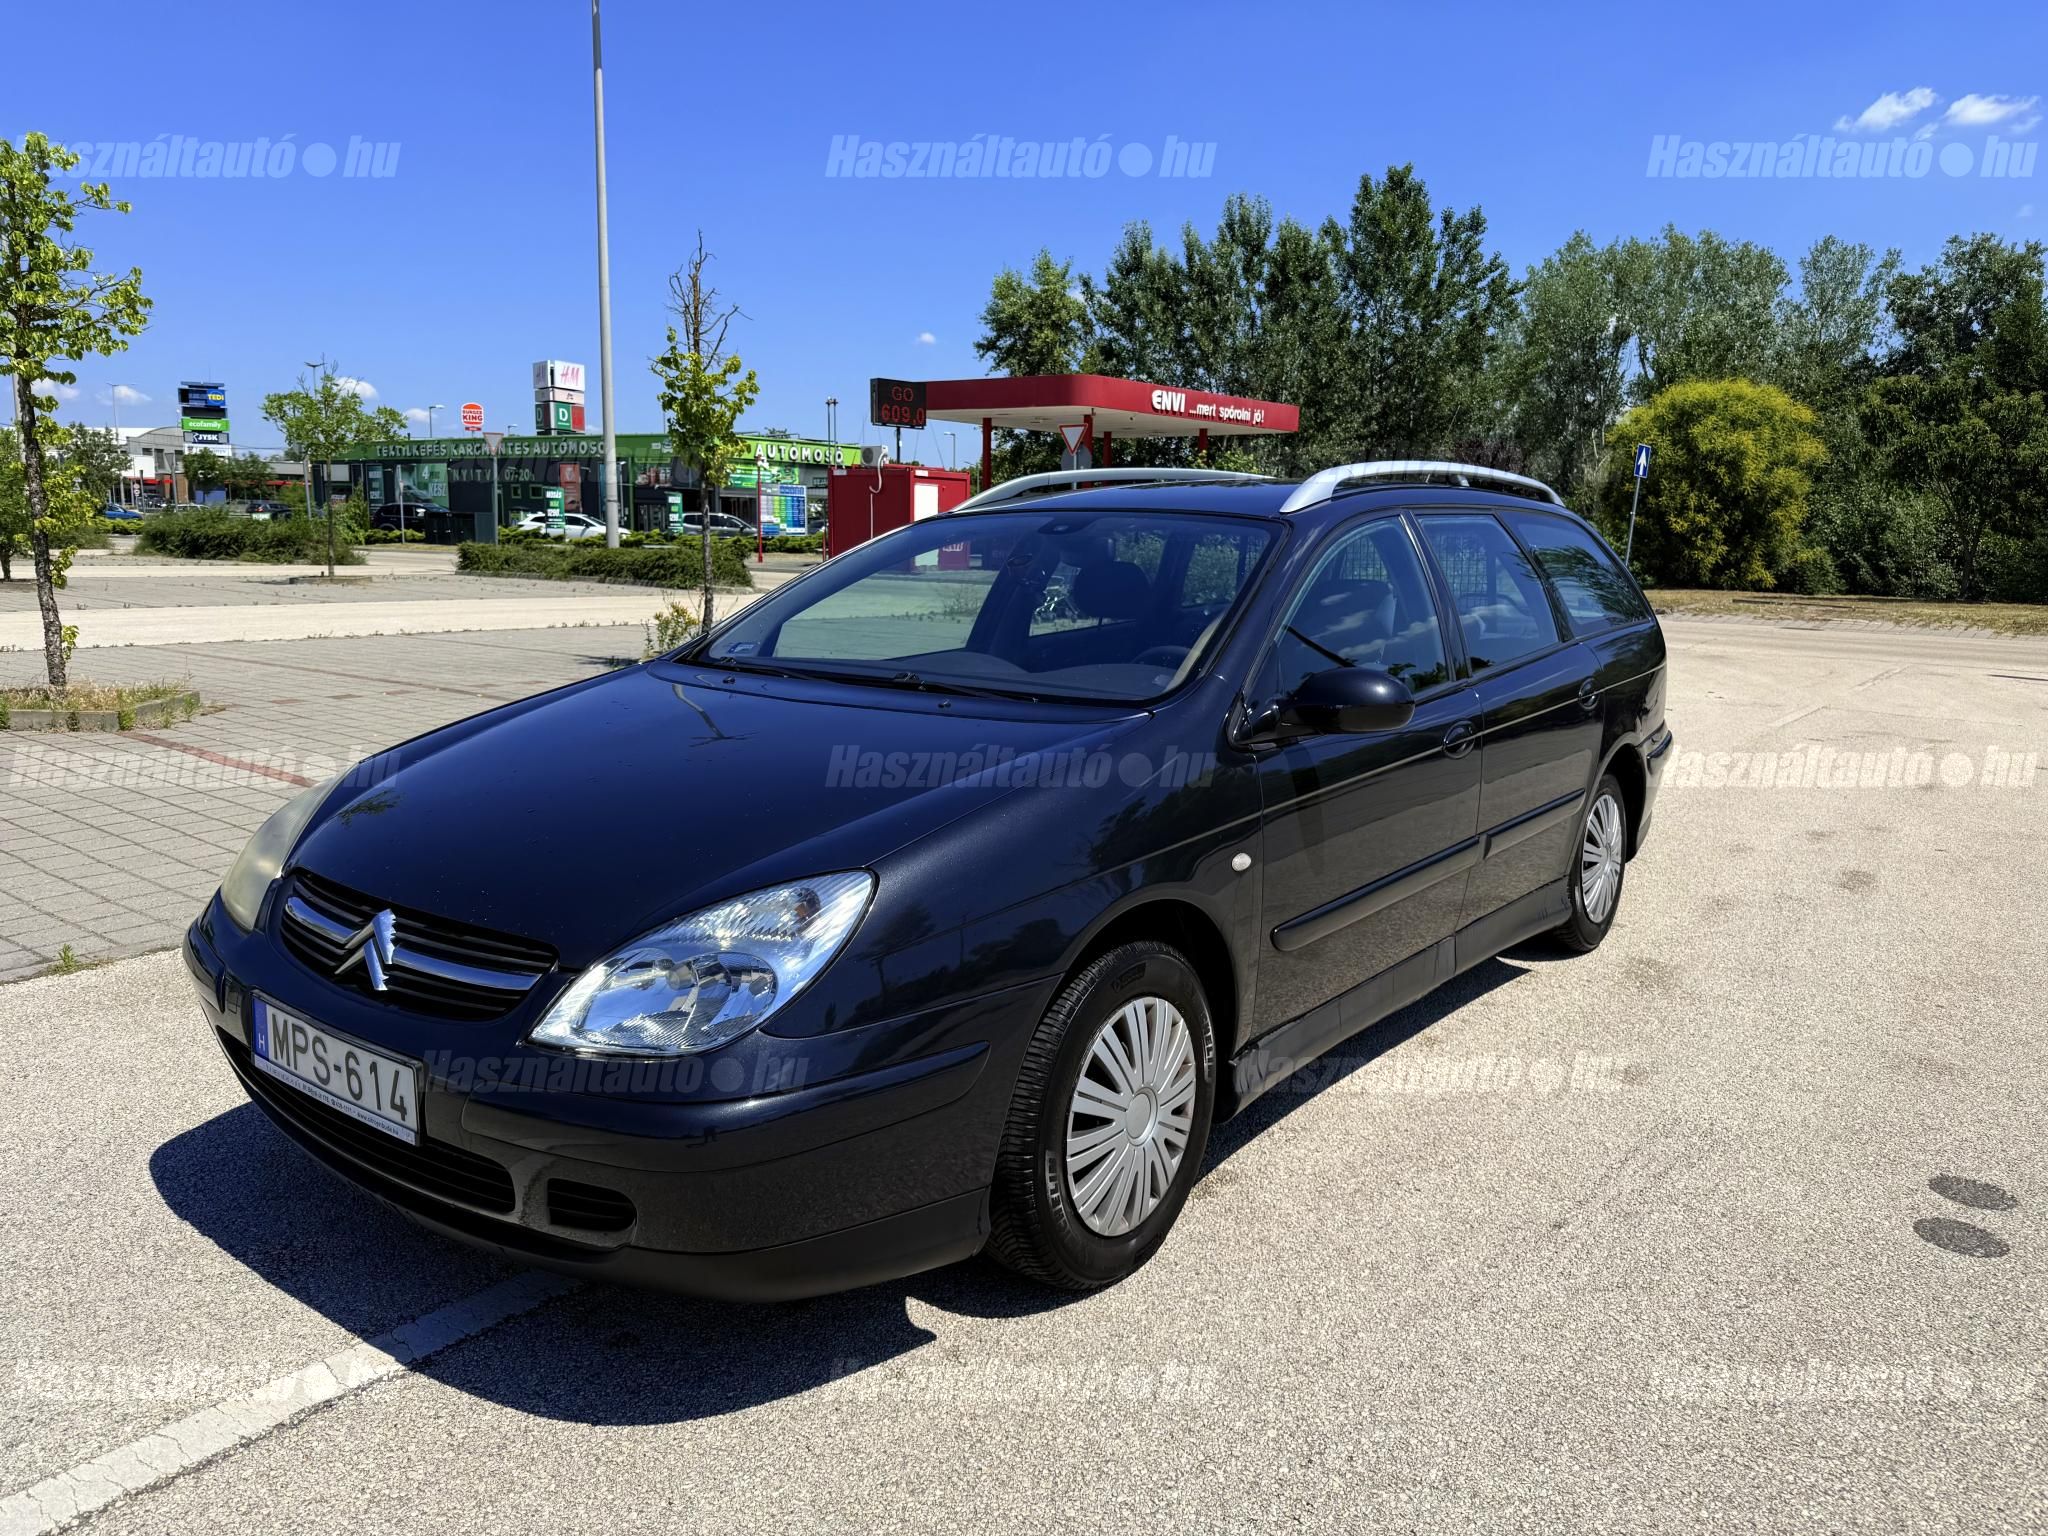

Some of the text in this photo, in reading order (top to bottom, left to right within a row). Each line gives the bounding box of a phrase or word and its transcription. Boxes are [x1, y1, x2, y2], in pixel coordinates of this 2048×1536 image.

[1151, 389, 1186, 413] ENVI
[1219, 404, 1251, 421] spórolni
[188, 421, 222, 429] ecofamily
[198, 433, 218, 441] JYSK
[450, 441, 530, 457] KARCMNTES
[453, 468, 499, 481] NYITV
[272, 1013, 408, 1122] MPS-614
